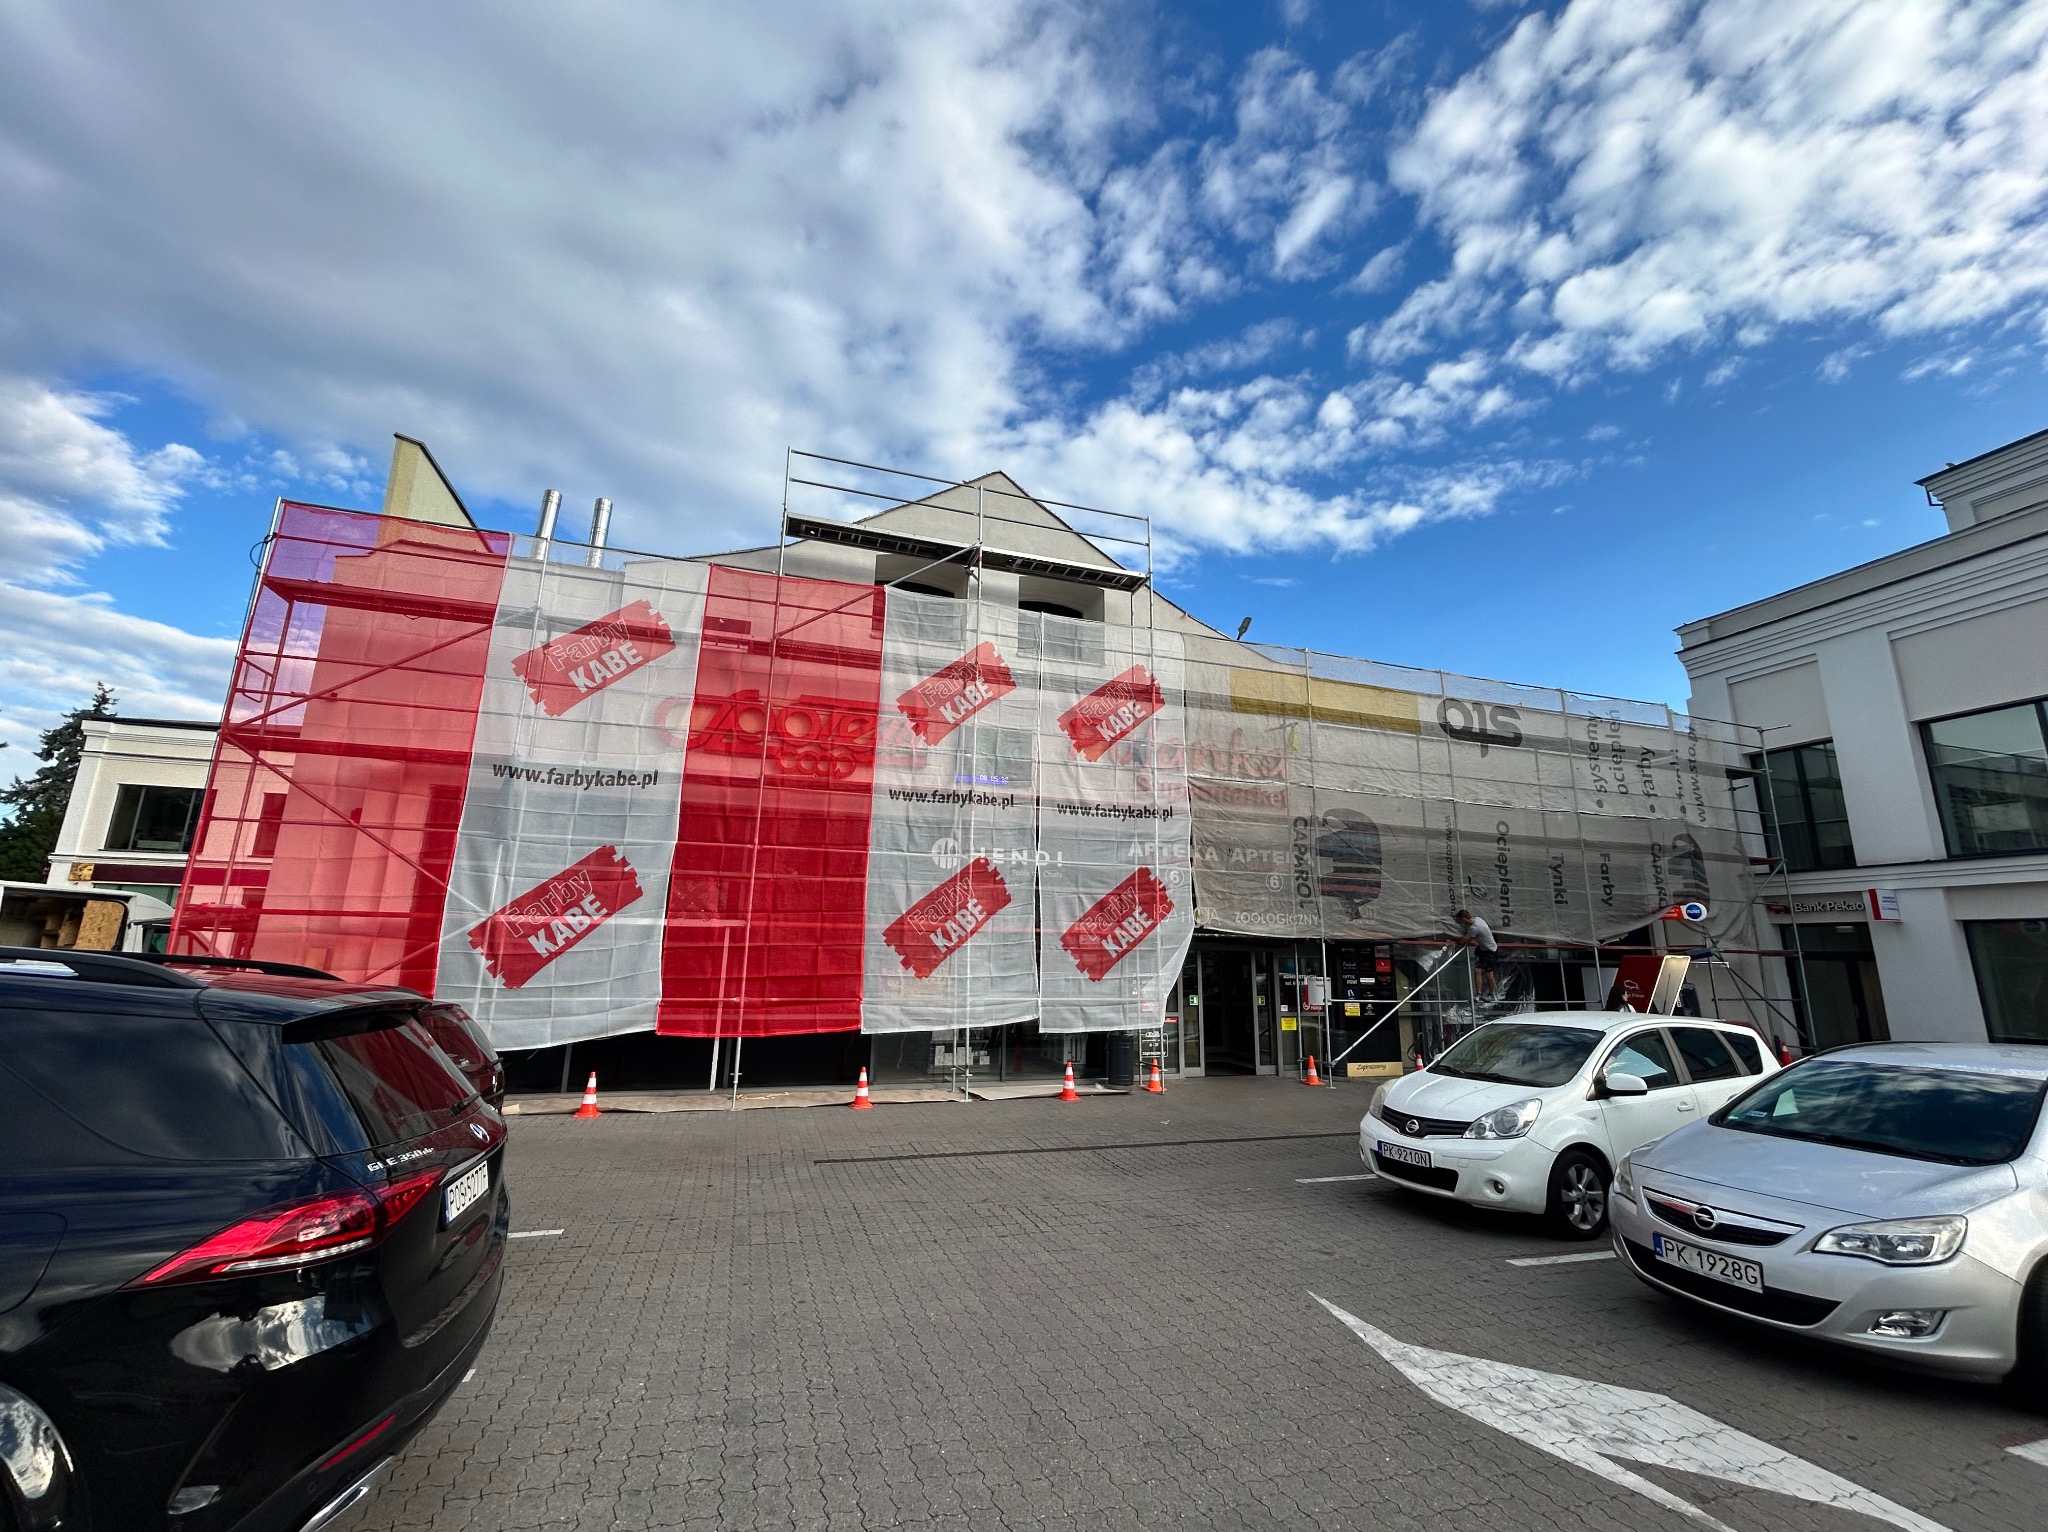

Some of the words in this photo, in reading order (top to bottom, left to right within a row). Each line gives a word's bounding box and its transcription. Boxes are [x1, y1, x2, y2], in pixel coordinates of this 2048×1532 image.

[544, 619, 630, 671] Farby
[568, 641, 643, 693] KABE
[917, 656, 984, 707] Farby
[939, 676, 994, 725] KABE
[1077, 680, 1134, 725] Farby
[1096, 700, 1146, 742] KABE
[492, 763, 659, 790] www.farbykabe.pl
[1586, 710, 1608, 794] systemy
[1605, 708, 1628, 795] ociepleń
[1637, 745, 1656, 798] farby
[889, 788, 1014, 810] www.farbykabe.pl
[1057, 802, 1173, 822] www.farbykabe.pl
[1293, 816, 1313, 909] CAPAROL
[1495, 820, 1513, 928] Ocieplenia
[1549, 853, 1568, 906] Tynki
[1600, 852, 1615, 907] Farby
[1650, 842, 1670, 909] CAPARO
[501, 870, 592, 938] Farby
[527, 893, 607, 958] KABE
[907, 876, 975, 935] Farby
[930, 897, 987, 954] KABE
[1080, 885, 1139, 941] Farby
[1234, 911, 1320, 926] ZOOLOGICZNY
[1794, 901, 1824, 912] Bank
[1826, 900, 1865, 911] Pekao
[1101, 906, 1154, 958] KABE
[367, 1157, 398, 1172] GLE
[1383, 1144, 1395, 1158] PK
[1397, 1147, 1428, 1167] 9210N
[1664, 1240, 1688, 1265] PK
[1696, 1250, 1758, 1285] 1928G
